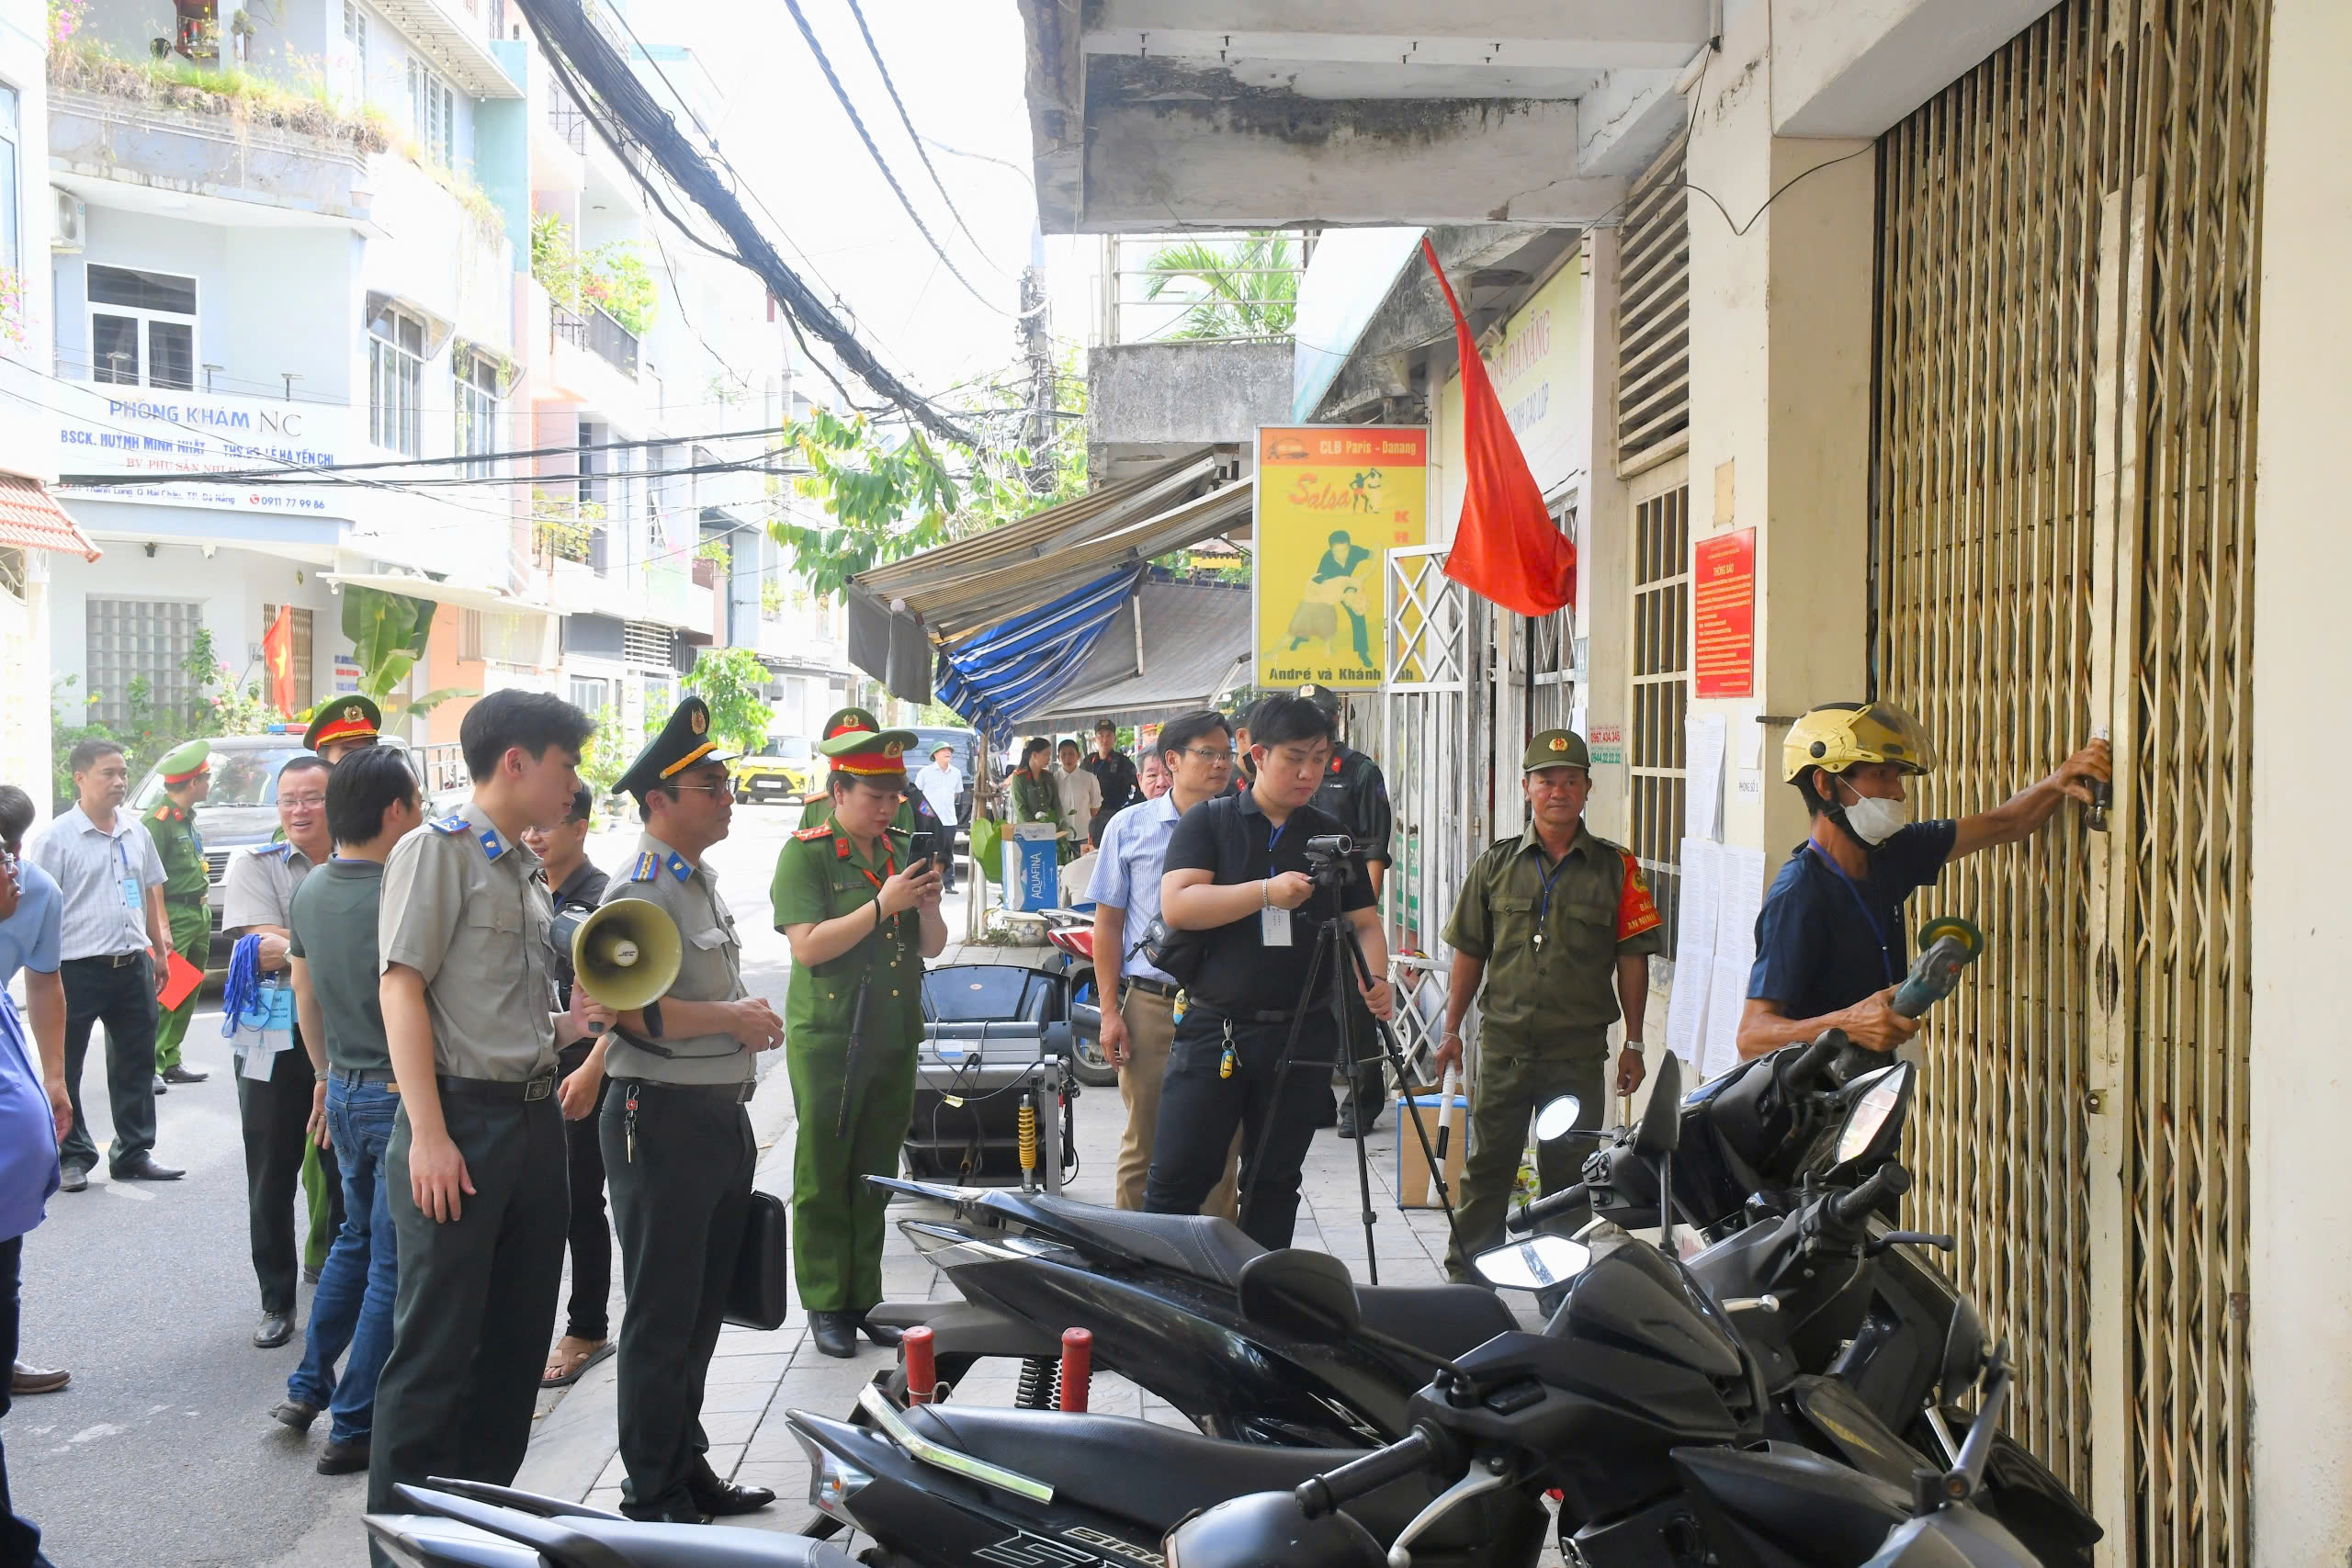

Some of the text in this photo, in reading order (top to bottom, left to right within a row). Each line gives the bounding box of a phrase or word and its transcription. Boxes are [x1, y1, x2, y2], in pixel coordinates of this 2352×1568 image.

[109, 399, 301, 436] PHÒNG KHÁM NC
[61, 429, 96, 446] BSCK.
[100, 431, 139, 449] HUỲNH
[143, 436, 173, 453] MINH
[317, 452, 334, 466] CHI
[1319, 440, 1342, 455] CLB
[1346, 439, 1372, 455] Paris
[1382, 440, 1417, 457] Danang
[261, 496, 282, 507] 0911
[286, 497, 297, 508] 77
[300, 499, 311, 509] 99
[313, 500, 325, 509] 86
[1288, 472, 1350, 510] Salsa
[1269, 668, 1311, 681] André
[1317, 667, 1332, 681] và
[1339, 668, 1381, 681] Khánh
[1030, 852, 1044, 899] AQUAFINA
[1627, 919, 1639, 931] AN
